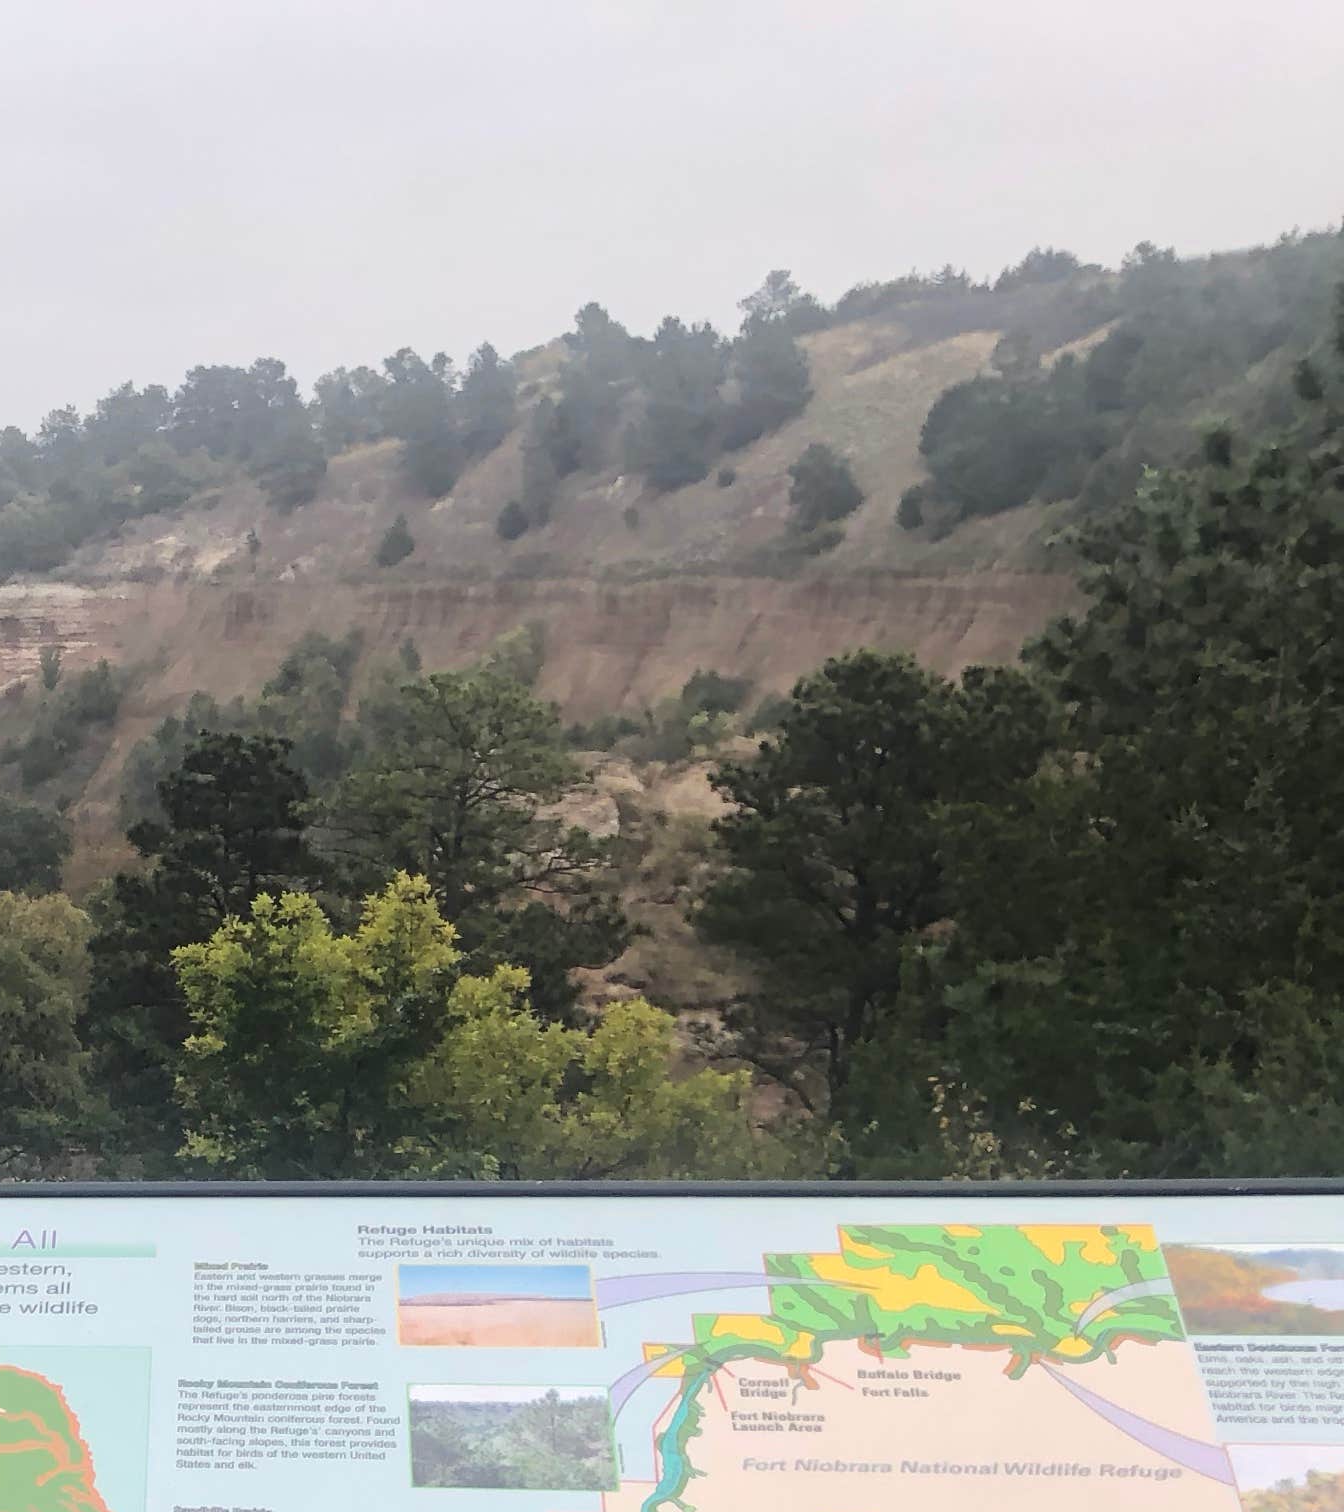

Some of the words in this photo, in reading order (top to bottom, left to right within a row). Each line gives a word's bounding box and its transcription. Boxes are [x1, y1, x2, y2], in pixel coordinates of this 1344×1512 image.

[357, 1224, 417, 1236] Refuge
[422, 1225, 493, 1234] Habitats
[7, 1229, 57, 1251] All
[357, 1236, 385, 1246] The
[389, 1237, 452, 1248] Refuge's
[456, 1237, 506, 1248] unique
[509, 1237, 534, 1246] mix
[538, 1237, 553, 1247] of
[556, 1237, 614, 1248] habitats
[357, 1249, 419, 1260] supports
[423, 1250, 433, 1258] a
[436, 1248, 463, 1258] rich
[467, 1248, 527, 1260] diversity
[530, 1249, 545, 1258] of
[547, 1249, 598, 1258] wildlife
[602, 1249, 659, 1260] species.
[45, 1280, 71, 1295] all
[18, 1300, 98, 1315] wildlife
[192, 1335, 213, 1344] that
[215, 1335, 235, 1344] live
[237, 1335, 248, 1344] in
[250, 1336, 268, 1345] the
[270, 1336, 338, 1346] mixed-grass
[340, 1336, 378, 1347] prairie.
[856, 1369, 909, 1380] Buffalo
[912, 1369, 962, 1382] Bridge
[738, 1376, 790, 1388] Cornell
[739, 1387, 787, 1399] Bridge
[861, 1386, 890, 1397] Fort
[893, 1387, 930, 1397] Falls
[177, 1413, 210, 1423] Rocky
[213, 1414, 265, 1423] Mountain
[267, 1414, 325, 1424] coniferous
[328, 1415, 363, 1424] forest.
[366, 1415, 401, 1425] Found
[730, 1410, 759, 1421] Fort
[761, 1411, 826, 1422] Niobrara
[731, 1421, 784, 1432] Launch
[787, 1422, 822, 1432] Area
[175, 1460, 211, 1469] States
[213, 1460, 235, 1469] and
[237, 1461, 257, 1470] elk.
[742, 1457, 787, 1472] Fort
[793, 1458, 893, 1474] Niobrara
[899, 1460, 999, 1475] National
[1003, 1461, 1092, 1477] Wildlife
[1098, 1463, 1183, 1480] Refuge
